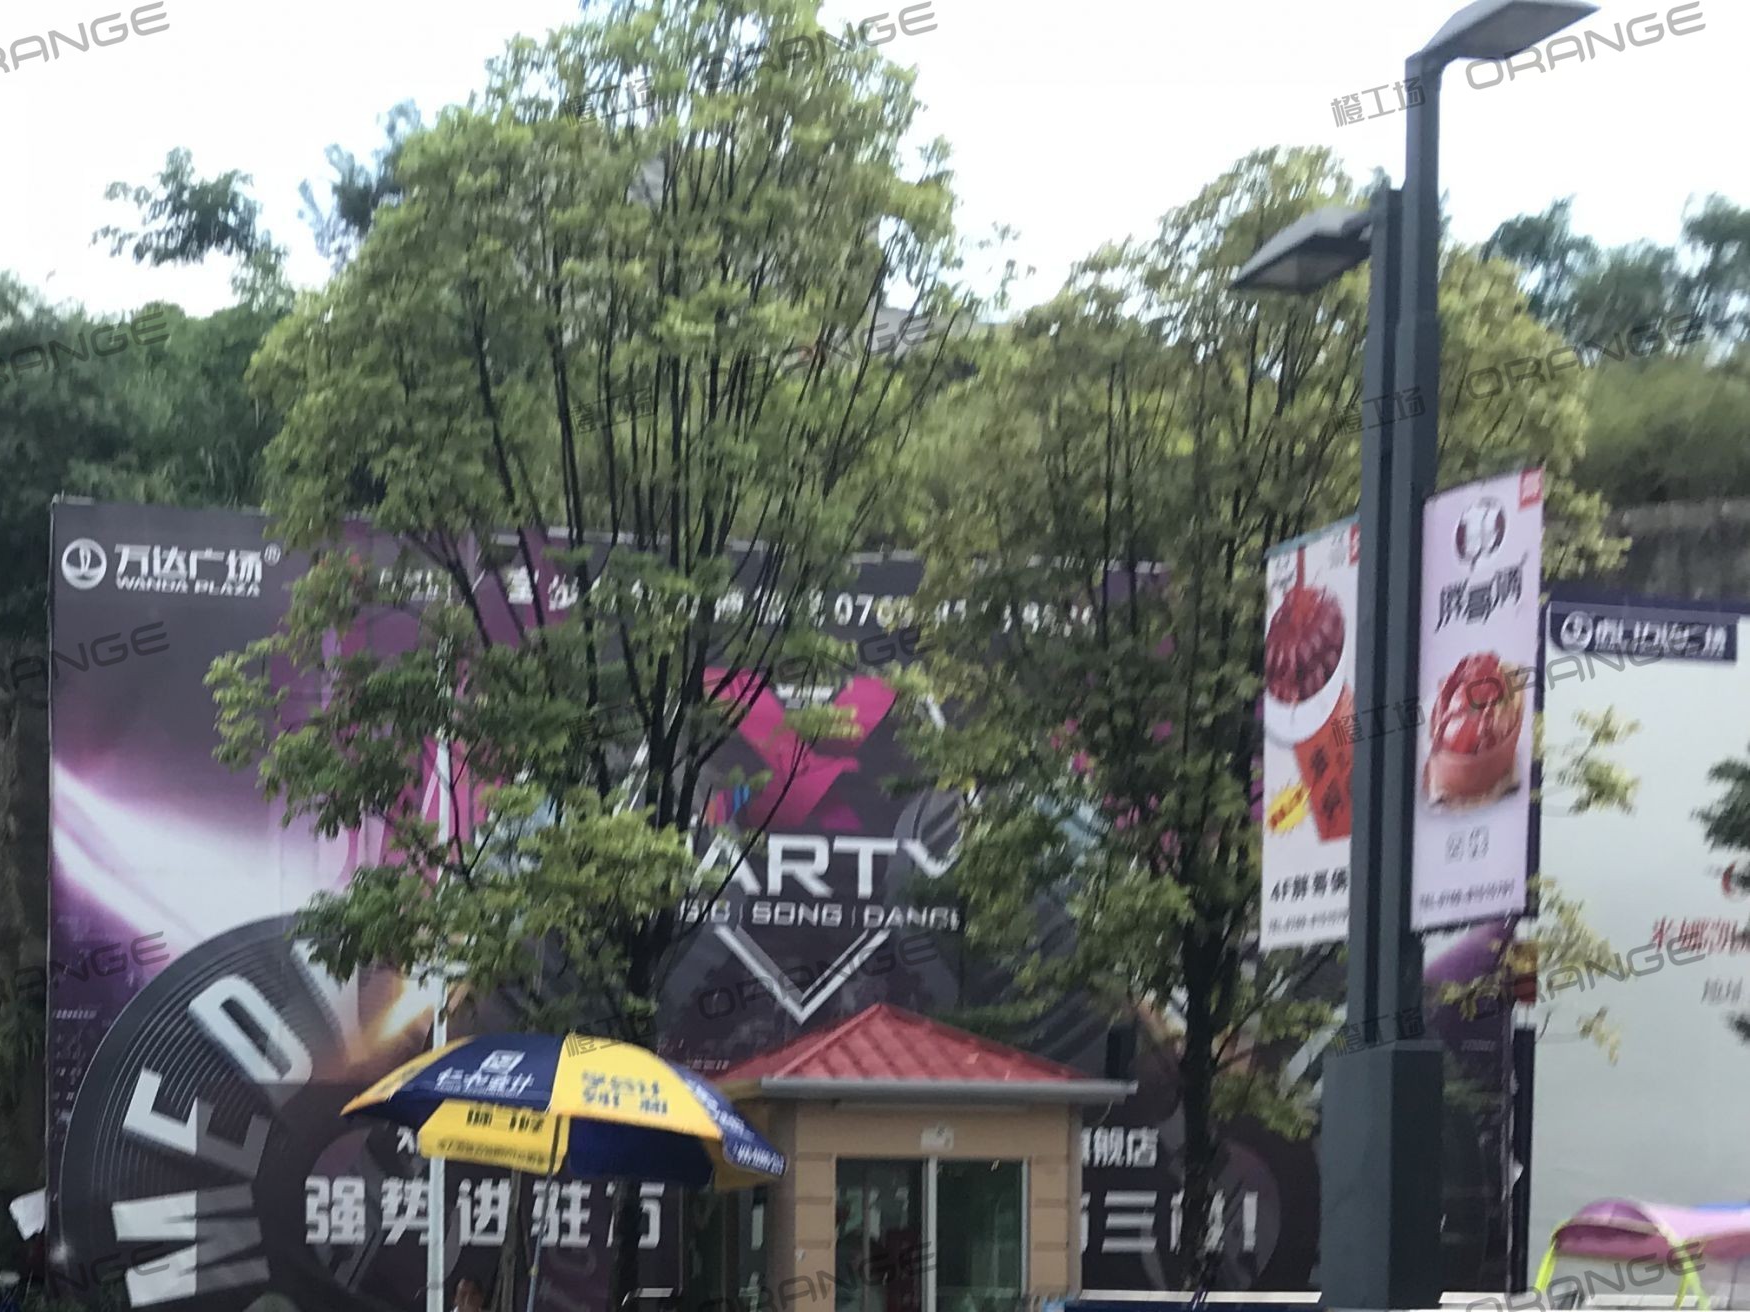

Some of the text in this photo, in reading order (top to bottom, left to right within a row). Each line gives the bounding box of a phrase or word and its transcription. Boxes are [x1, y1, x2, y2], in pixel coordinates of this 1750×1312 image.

[115, 543, 263, 584] 万达广场
[116, 575, 261, 597] WANDA PLAZA
[752, 901, 842, 928] SONG
